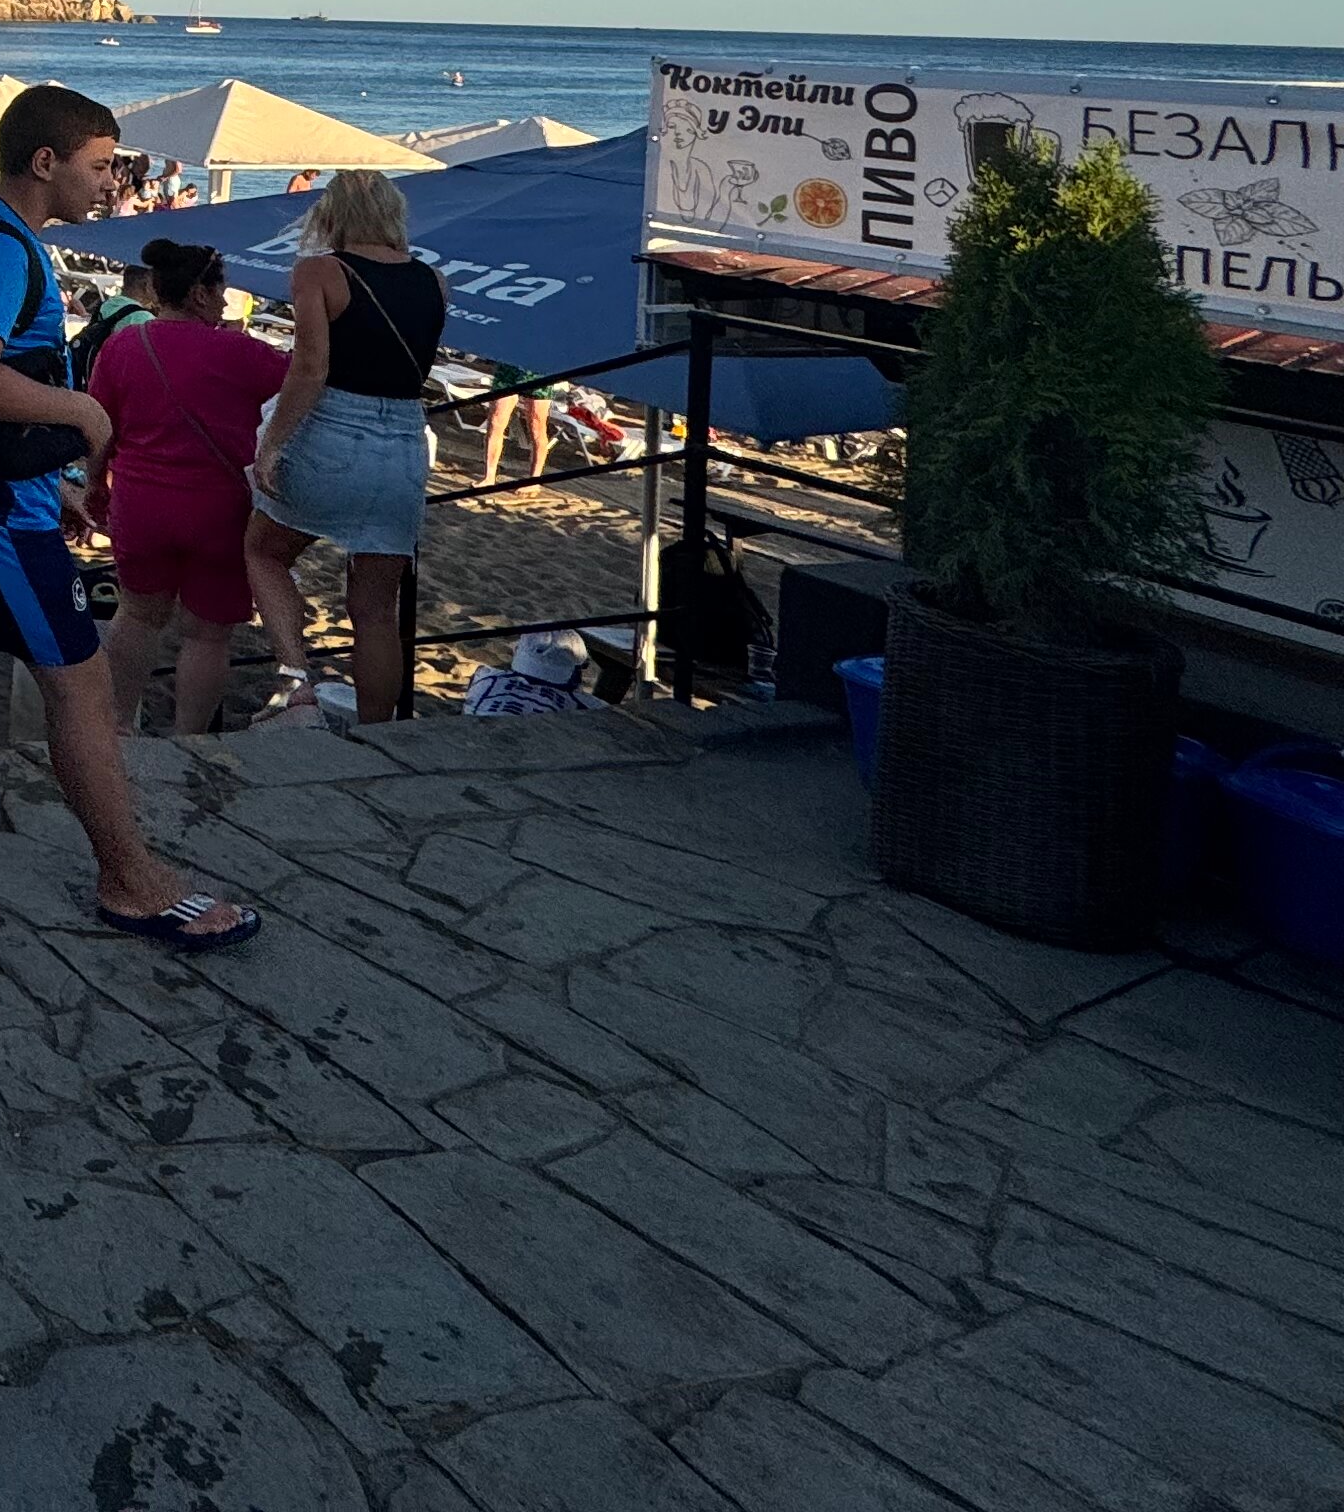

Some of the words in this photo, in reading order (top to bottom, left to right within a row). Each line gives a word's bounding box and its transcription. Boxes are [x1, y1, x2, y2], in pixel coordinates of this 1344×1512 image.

[660, 63, 855, 106] Коктейли
[706, 108, 730, 134] у
[736, 105, 805, 137] Эли
[861, 82, 918, 250] ПИВО
